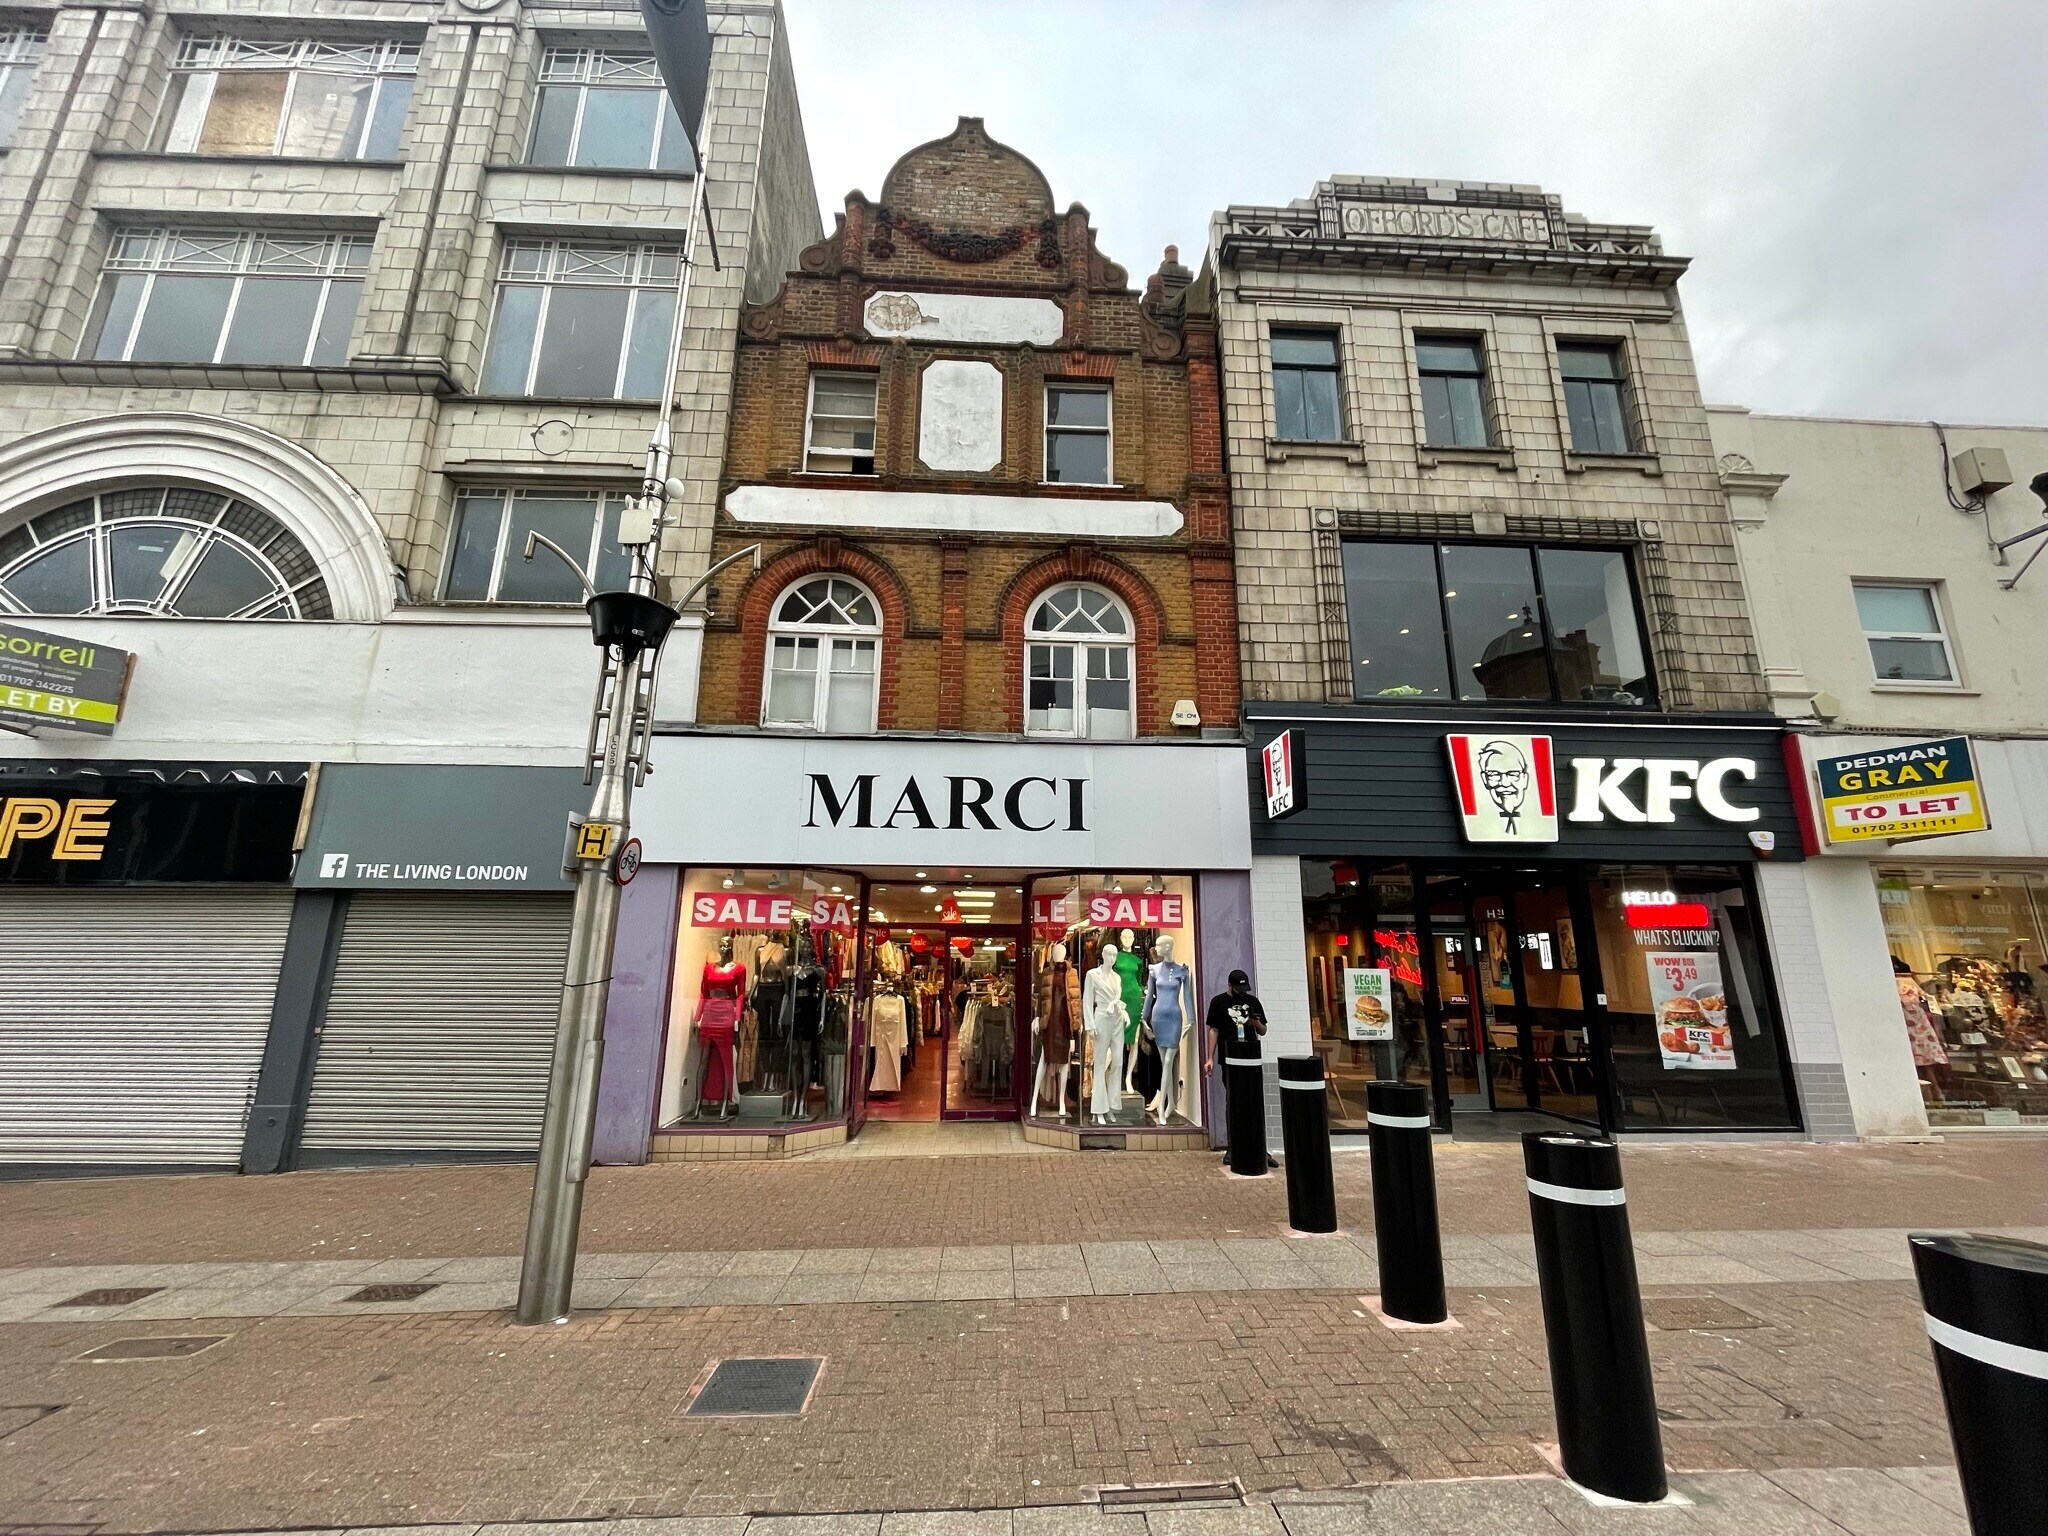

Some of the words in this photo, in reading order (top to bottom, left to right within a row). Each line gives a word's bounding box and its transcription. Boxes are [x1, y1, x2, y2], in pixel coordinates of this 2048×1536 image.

[35, 680, 75, 694] 342225
[48, 696, 82, 715] BY
[1836, 746, 1947, 771] DEDMAN
[1839, 760, 1949, 791] GRAY
[1568, 758, 1760, 822] KFC
[1866, 788, 1928, 801] Commercial
[801, 773, 1091, 832] MARCI
[1271, 793, 1289, 815] KFC
[1845, 806, 1887, 820] TO
[1899, 797, 1960, 816] LET
[1852, 824, 1896, 834] 01702
[1901, 818, 1957, 830] 311111
[581, 827, 607, 856] H
[355, 863, 391, 879] THE
[393, 864, 451, 879] LIVING
[455, 865, 528, 881] LONDON
[1622, 891, 1677, 906] HELLO
[694, 897, 792, 924] SALE
[812, 900, 851, 926] SA
[1034, 899, 1067, 923] LE
[1090, 897, 1182, 923] SALE
[1634, 930, 1670, 945] WHAT'S
[1654, 957, 1682, 966] WOW
[1682, 958, 1696, 966] BOX
[1353, 974, 1382, 986] VEGAN
[1665, 967, 1697, 992] £3.49
[1689, 1030, 1710, 1039] KFC
